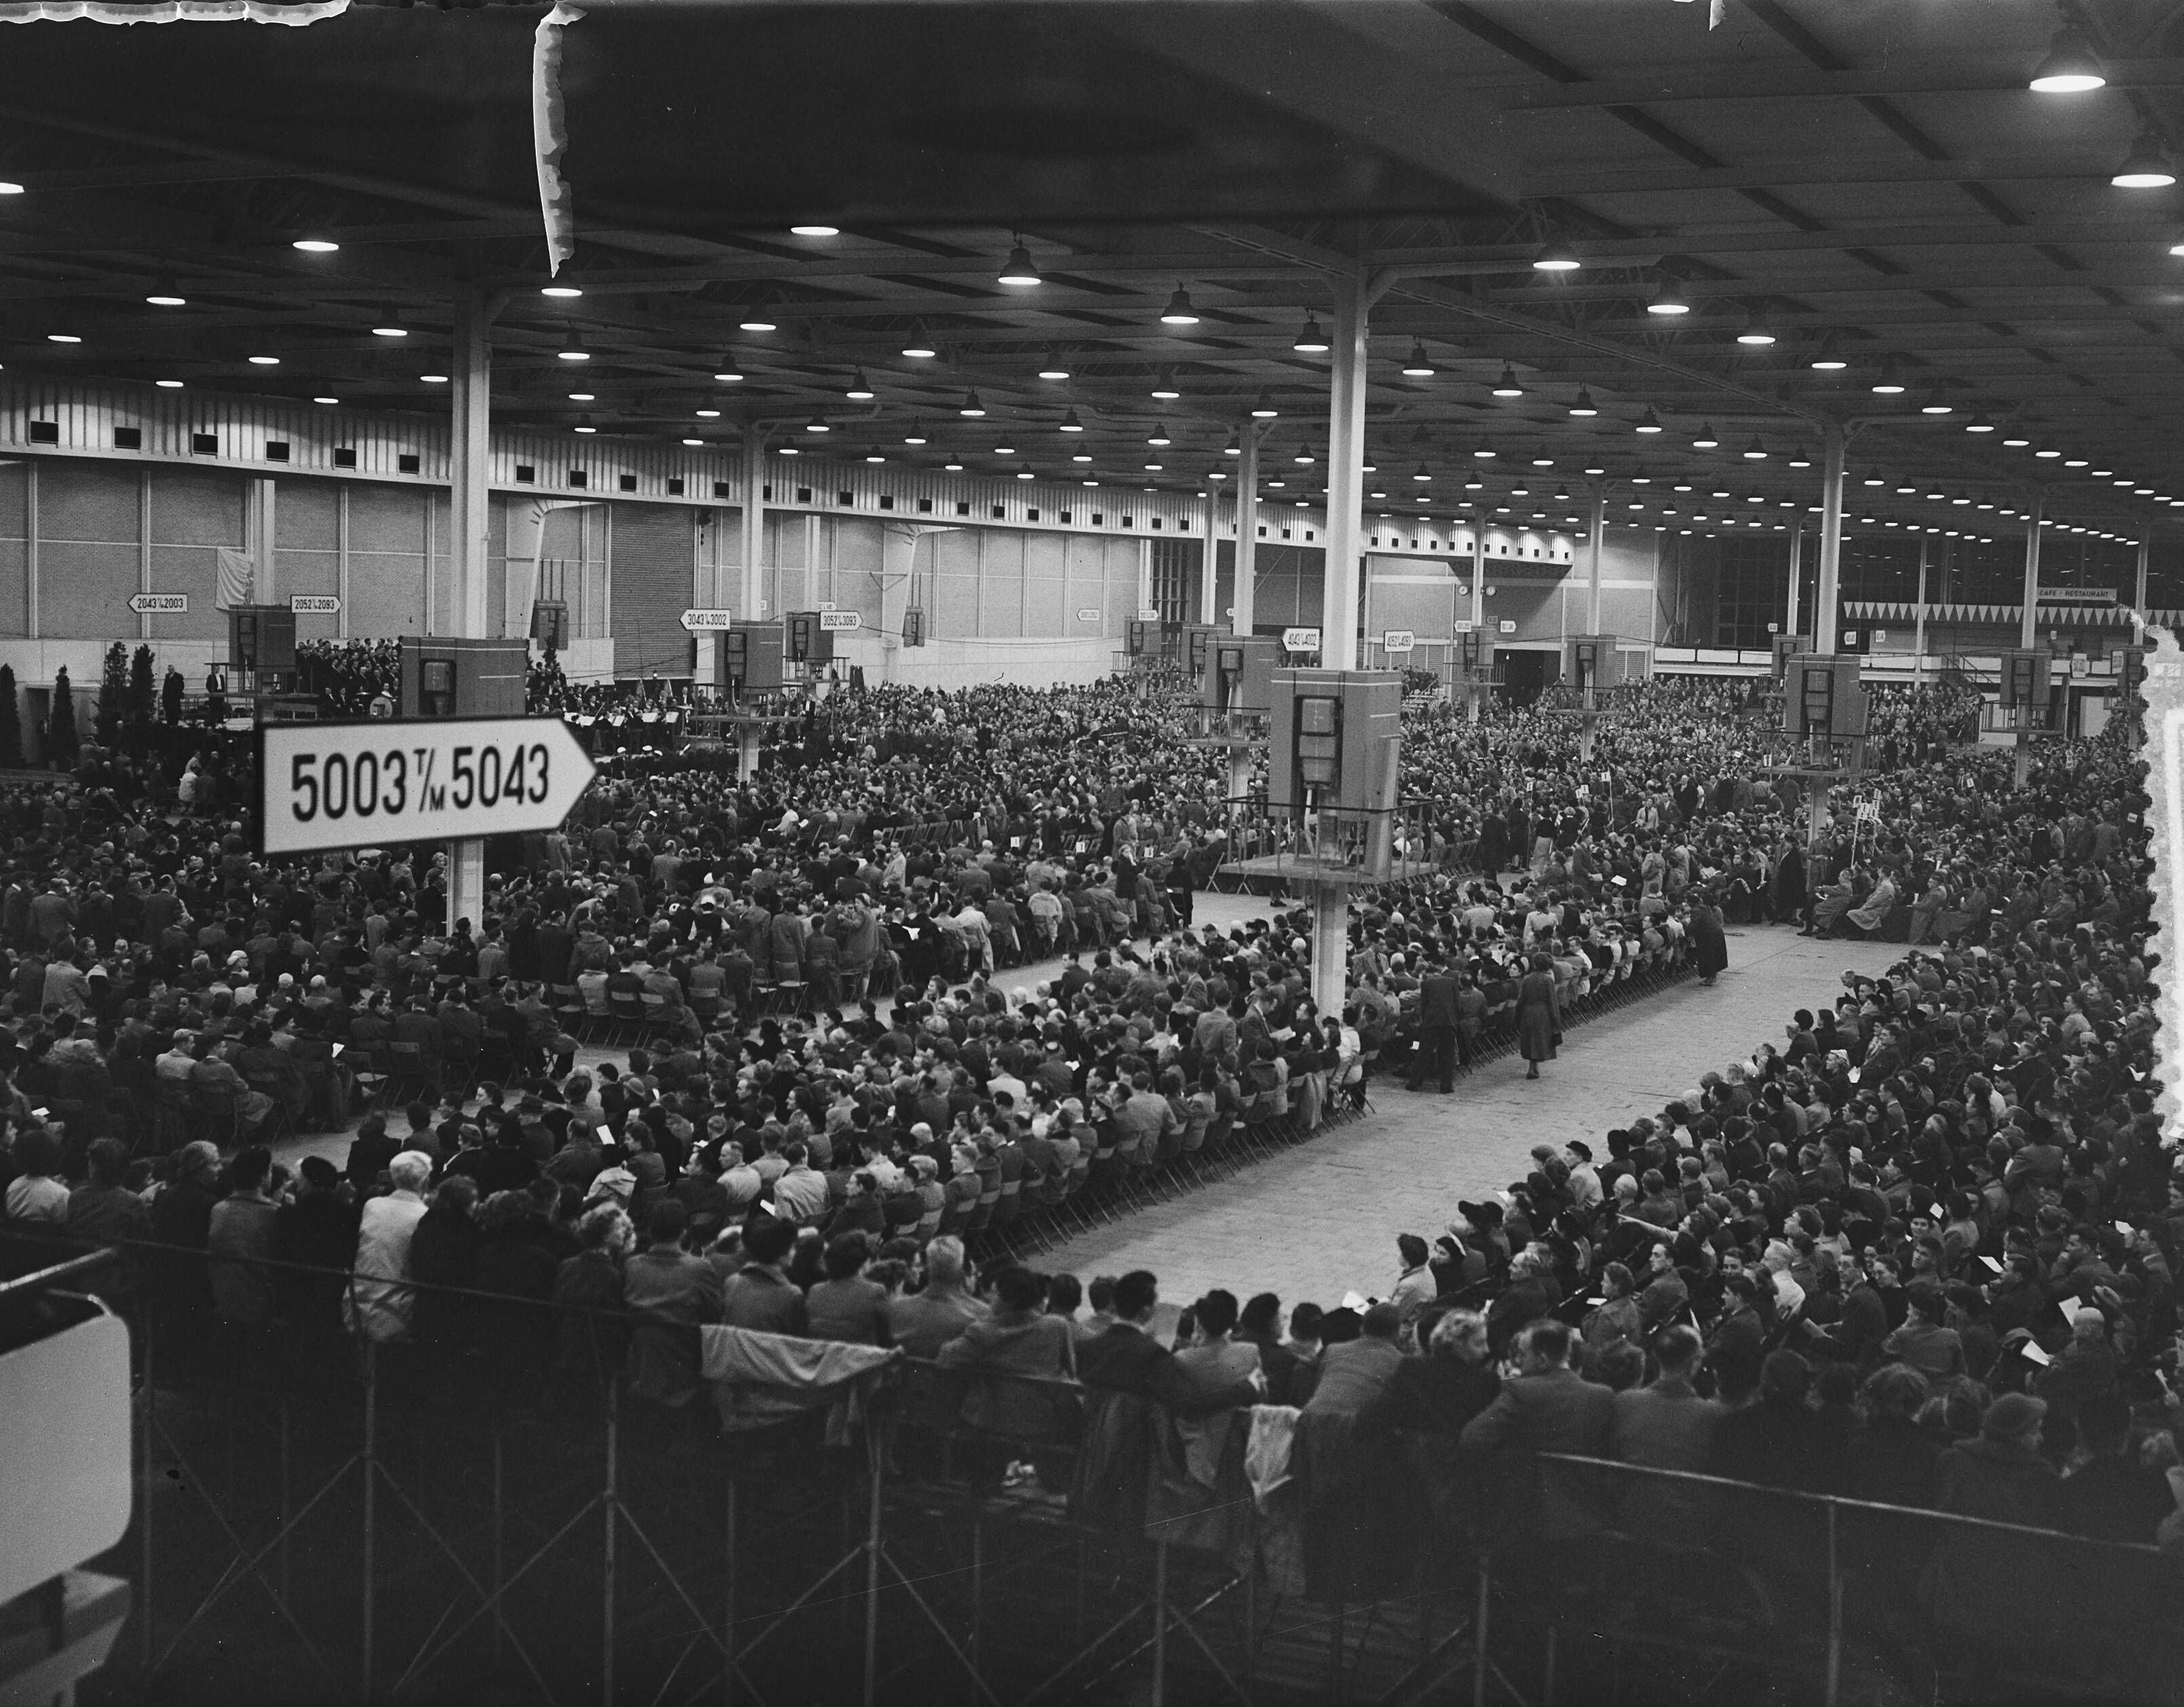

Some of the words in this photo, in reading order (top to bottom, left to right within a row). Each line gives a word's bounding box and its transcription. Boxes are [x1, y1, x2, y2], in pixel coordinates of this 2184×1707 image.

[137, 598, 157, 609] 2043
[164, 598, 183, 609] 2003
[295, 599, 312, 609] 2052
[317, 599, 334, 609] 2093
[688, 613, 704, 625] 3043
[710, 613, 727, 626] 3002
[291, 749, 407, 822] 5003
[452, 744, 549, 809] 5043
